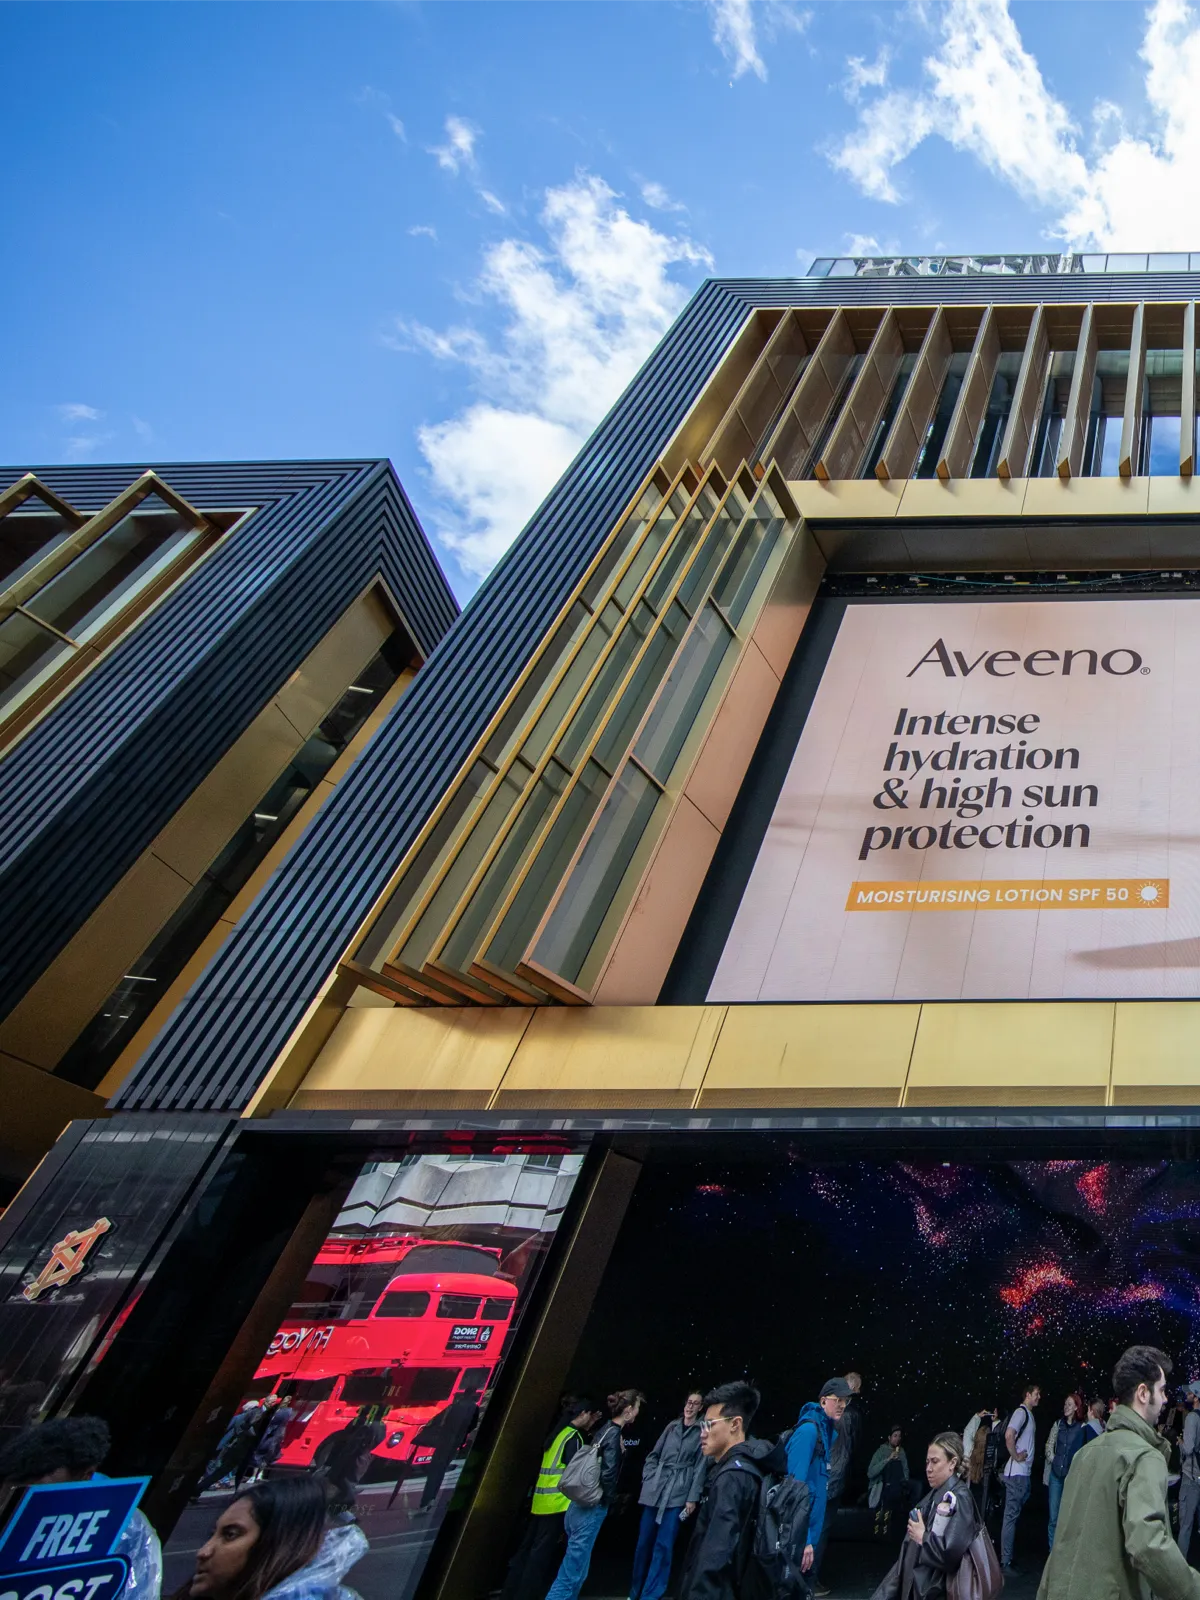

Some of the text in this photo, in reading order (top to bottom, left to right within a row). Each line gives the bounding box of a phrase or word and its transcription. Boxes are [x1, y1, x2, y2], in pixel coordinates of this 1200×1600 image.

[893, 708, 1041, 736] Intense
[883, 740, 1080, 780] hydration
[873, 776, 1099, 819] & high sun
[858, 815, 1091, 861] protection
[857, 887, 1130, 904] MOISTURISING LOTION SPF 50
[18, 1509, 110, 1562] FREE
